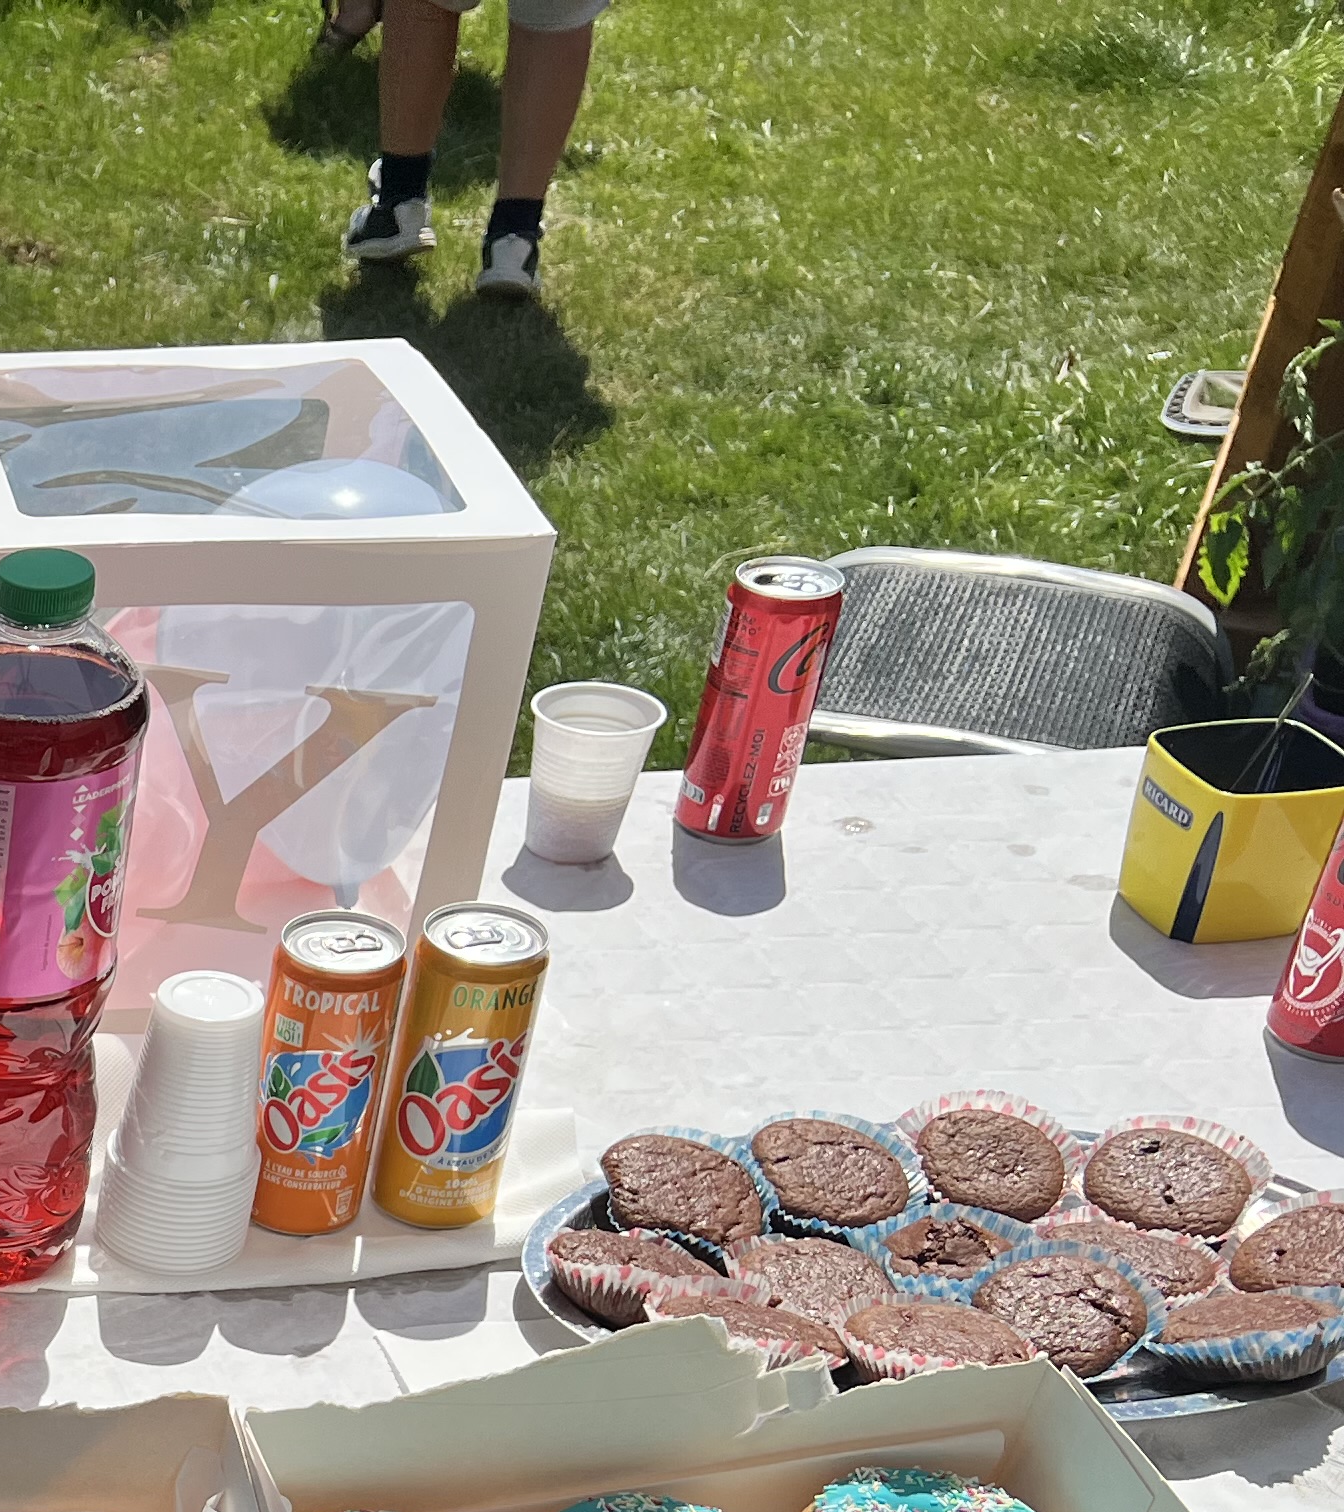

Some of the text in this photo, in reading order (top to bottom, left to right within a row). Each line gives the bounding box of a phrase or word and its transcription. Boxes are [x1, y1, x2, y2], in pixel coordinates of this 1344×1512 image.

[1144, 780, 1189, 824] RICARD
[283, 976, 380, 1015] TROPICAL
[263, 1049, 377, 1152] Oasis
